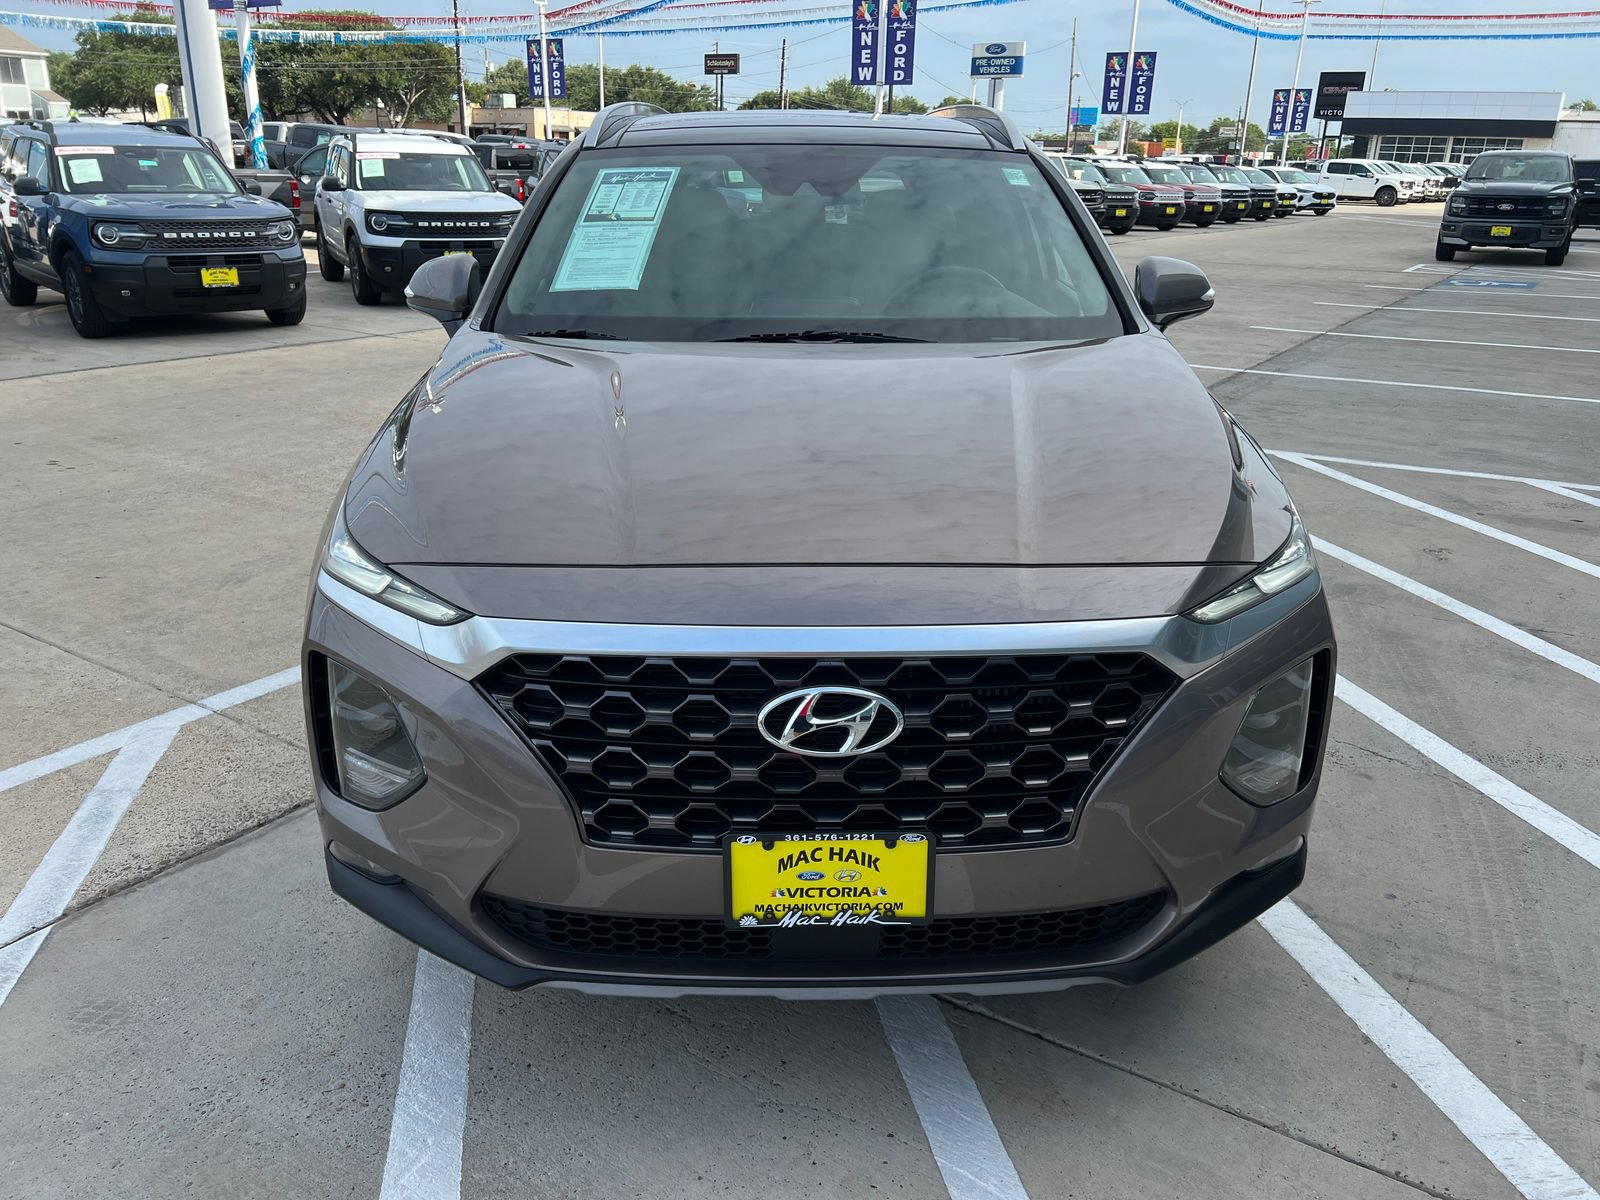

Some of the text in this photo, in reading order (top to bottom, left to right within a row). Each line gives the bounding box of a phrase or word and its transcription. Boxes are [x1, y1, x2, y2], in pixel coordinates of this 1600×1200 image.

[858, 31, 873, 81] NEW
[893, 30, 907, 81] FORD
[975, 58, 1016, 66] PRE-OWNED
[533, 63, 542, 96] NEW
[552, 62, 561, 96] FORD
[979, 66, 1011, 74] VEHICLES
[1107, 77, 1120, 112] NEW
[1134, 76, 1147, 112] FORD
[1273, 106, 1284, 131] NEW
[1294, 105, 1304, 131] FORD
[163, 231, 256, 239] BRONCO
[784, 833, 876, 842] 361-576-1221
[777, 846, 881, 874] MAC HAIK
[800, 872, 822, 880] Ford
[785, 886, 872, 899] VICTORIA
[754, 902, 904, 913] MACHAIKVICTORIACOM
[778, 909, 882, 928] Mac Haik
